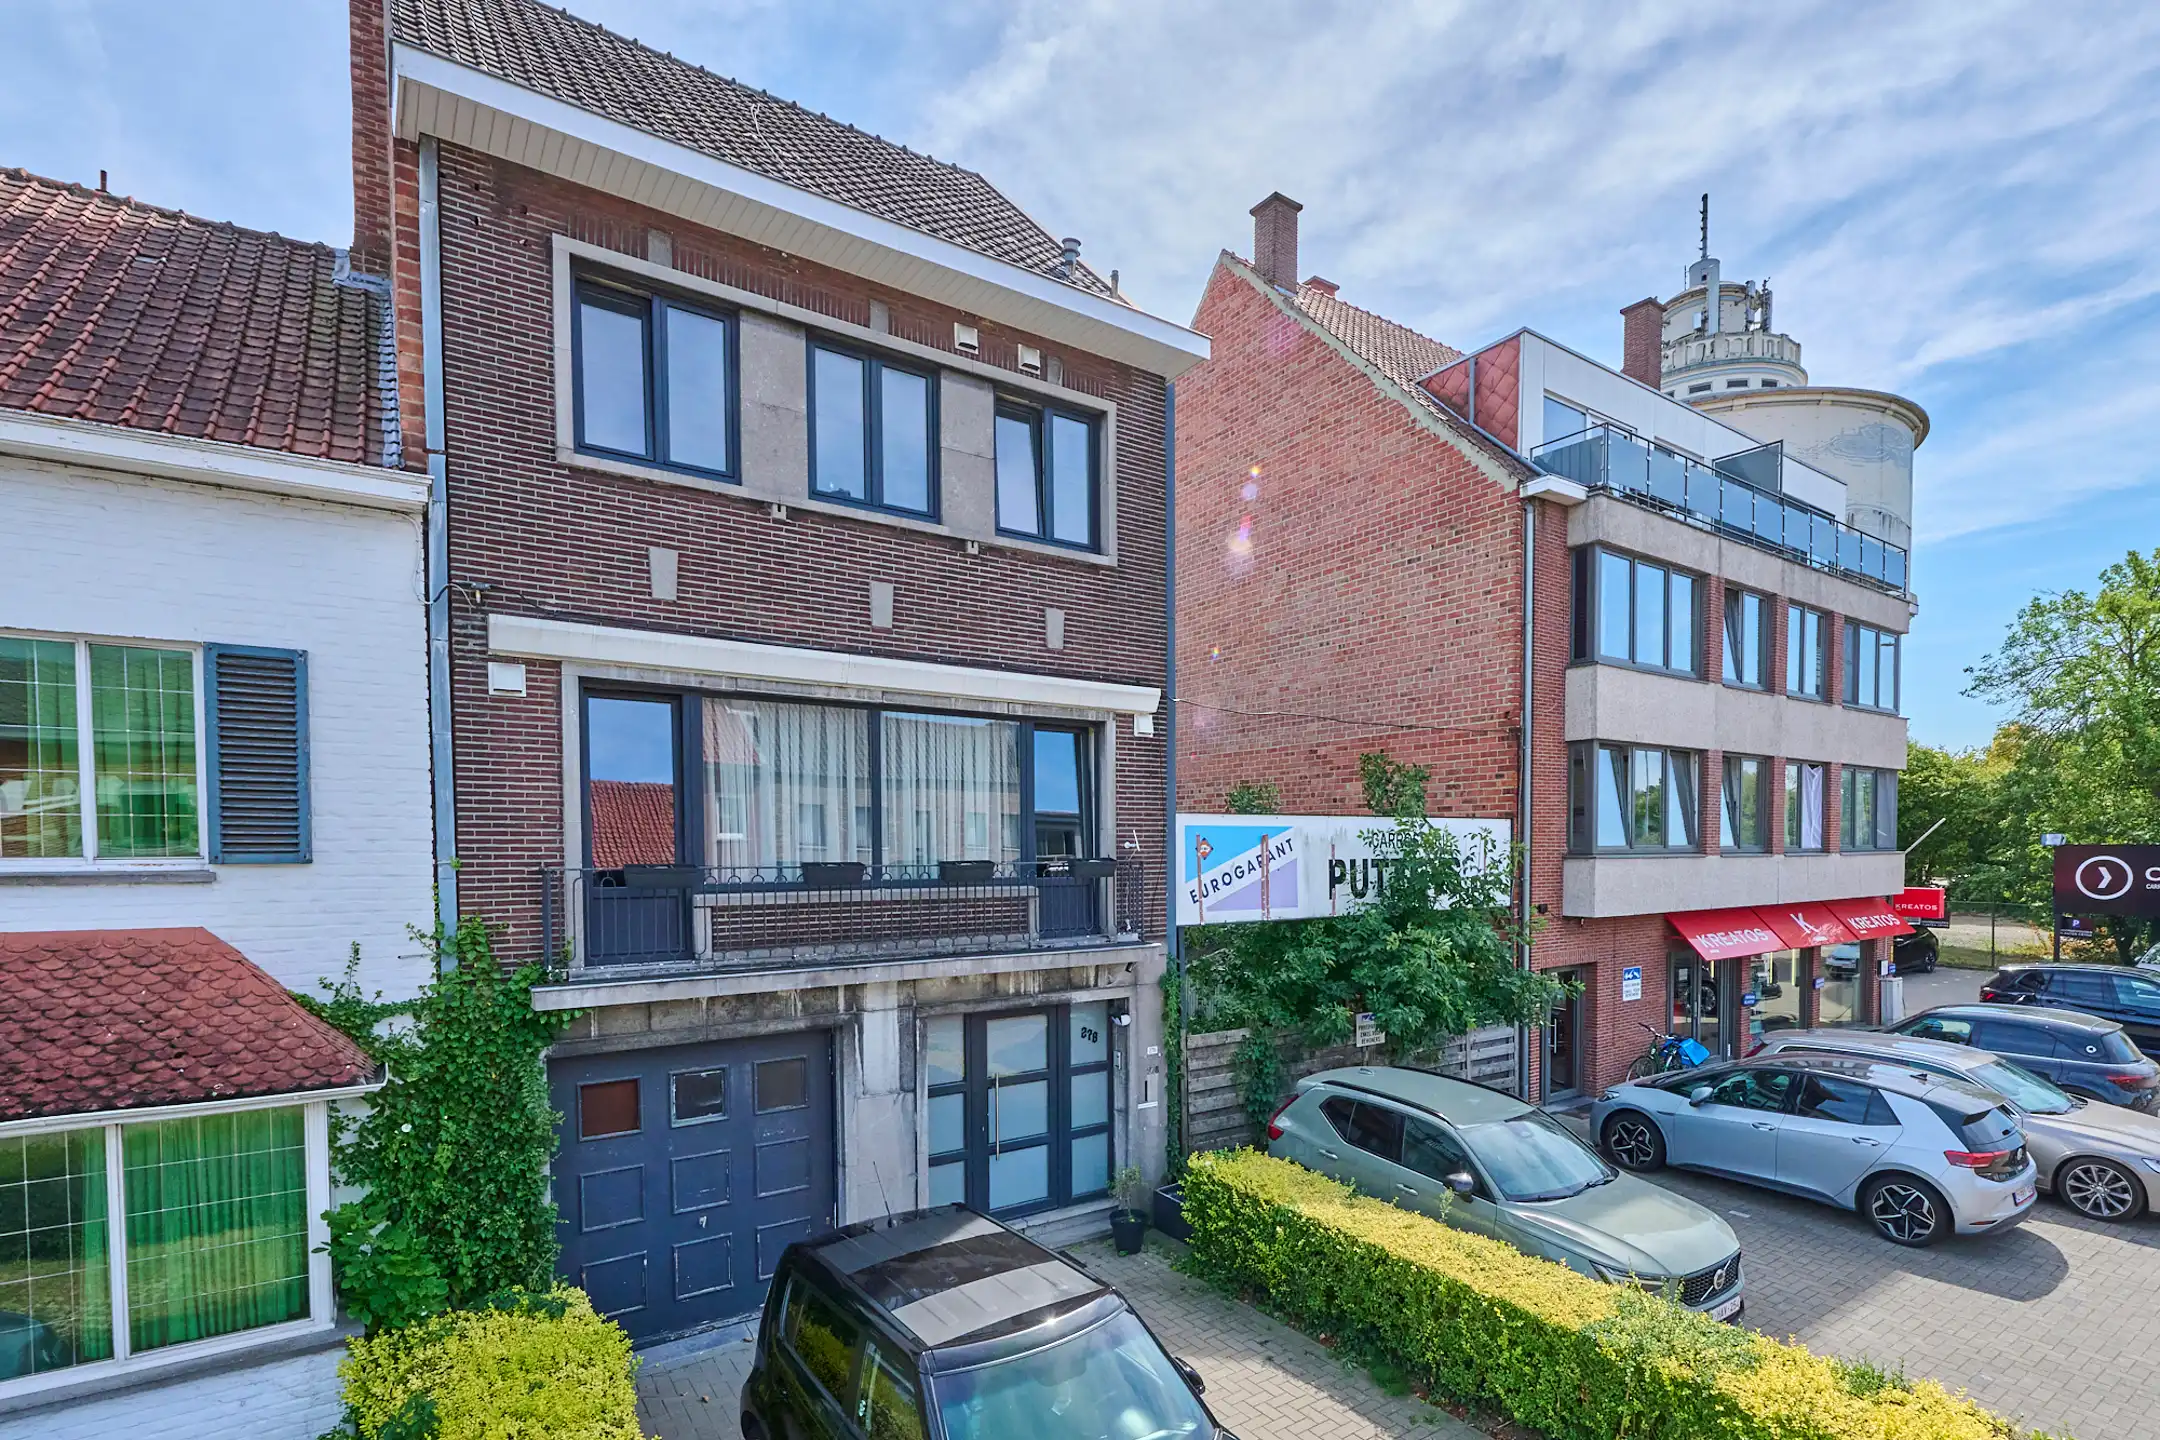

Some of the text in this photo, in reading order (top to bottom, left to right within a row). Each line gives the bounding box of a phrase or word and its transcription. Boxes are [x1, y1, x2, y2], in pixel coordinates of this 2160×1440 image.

[1189, 838, 1294, 904] EUROGARANT
[1895, 903, 1938, 911] KREATOS
[1789, 913, 1820, 934] K
[1847, 913, 1900, 930] KREATOS
[1696, 928, 1769, 948] KREATOS
